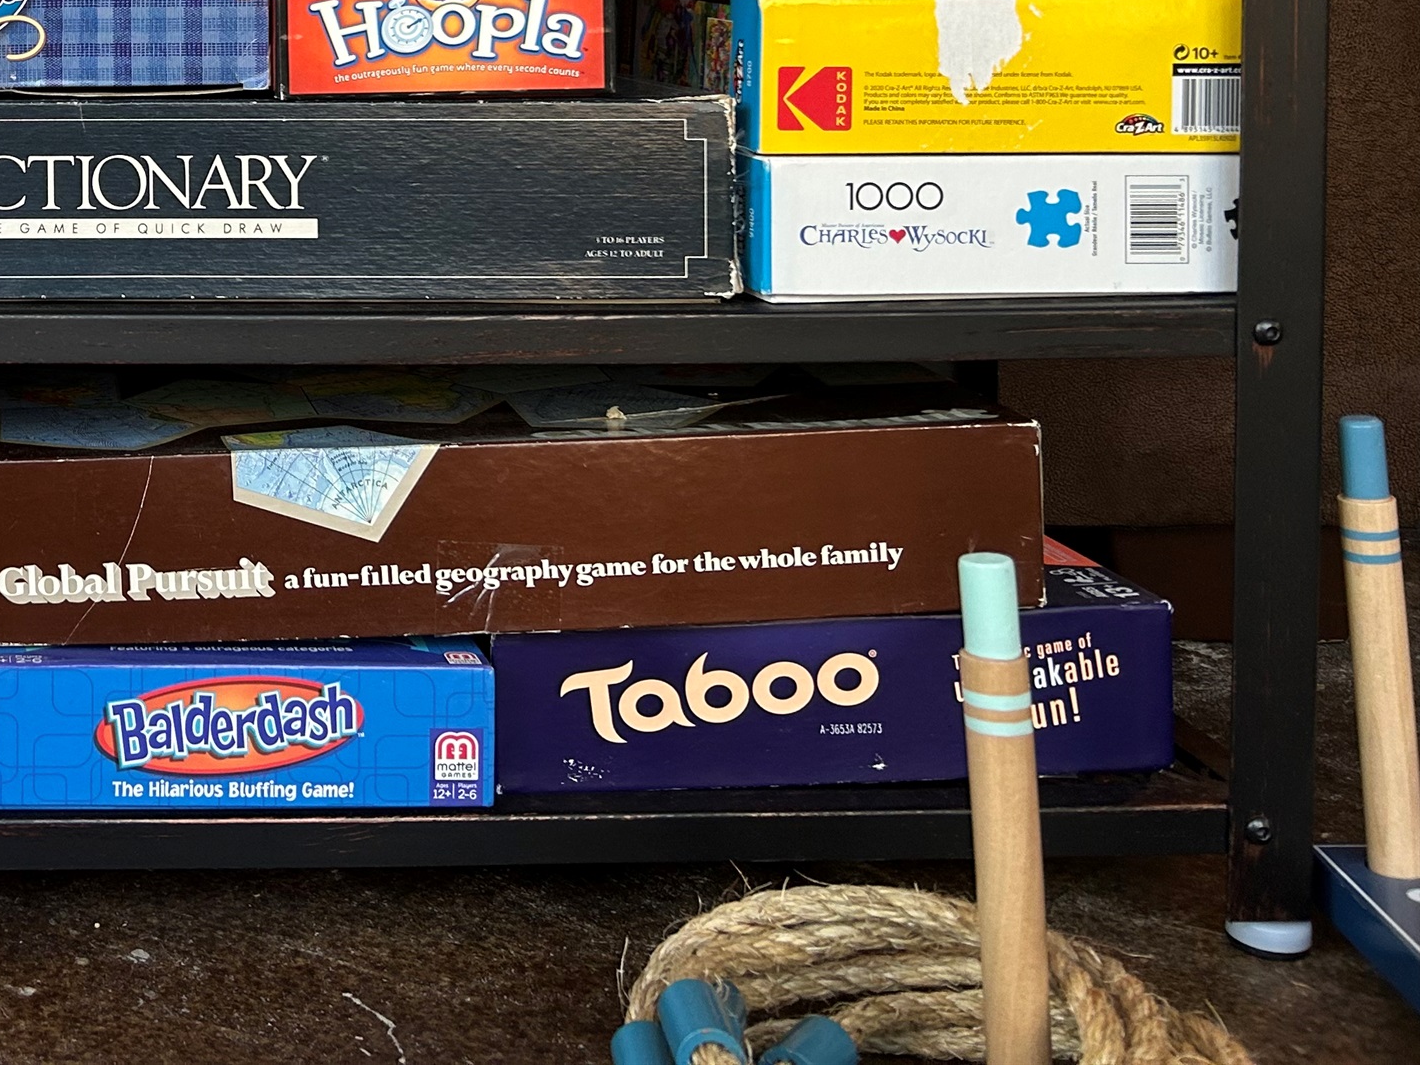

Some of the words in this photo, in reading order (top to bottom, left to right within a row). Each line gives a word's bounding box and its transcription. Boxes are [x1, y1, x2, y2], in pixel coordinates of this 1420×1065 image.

[836, 71, 847, 128] KODAK
[845, 181, 944, 211] 1000
[19, 223, 79, 235] GAME
[96, 223, 123, 235] OF
[137, 222, 206, 235] QUICK
[223, 222, 284, 235] DRAW
[127, 557, 277, 599] Pursuit
[284, 573, 299, 589] a
[303, 563, 431, 588] fun-filled
[435, 560, 573, 593] geography
[576, 559, 647, 587] game
[651, 553, 689, 575] for
[693, 551, 737, 573] the
[738, 547, 817, 570] whole
[820, 542, 904, 571] family
[559, 650, 880, 744] Taboo
[107, 681, 361, 769] Balderdash
[820, 724, 855, 735] A-3653A
[857, 723, 882, 734] 82573
[112, 781, 144, 798] The
[148, 779, 224, 799] Hilarious
[229, 780, 297, 801] Bluffing
[301, 780, 354, 798] Game!
